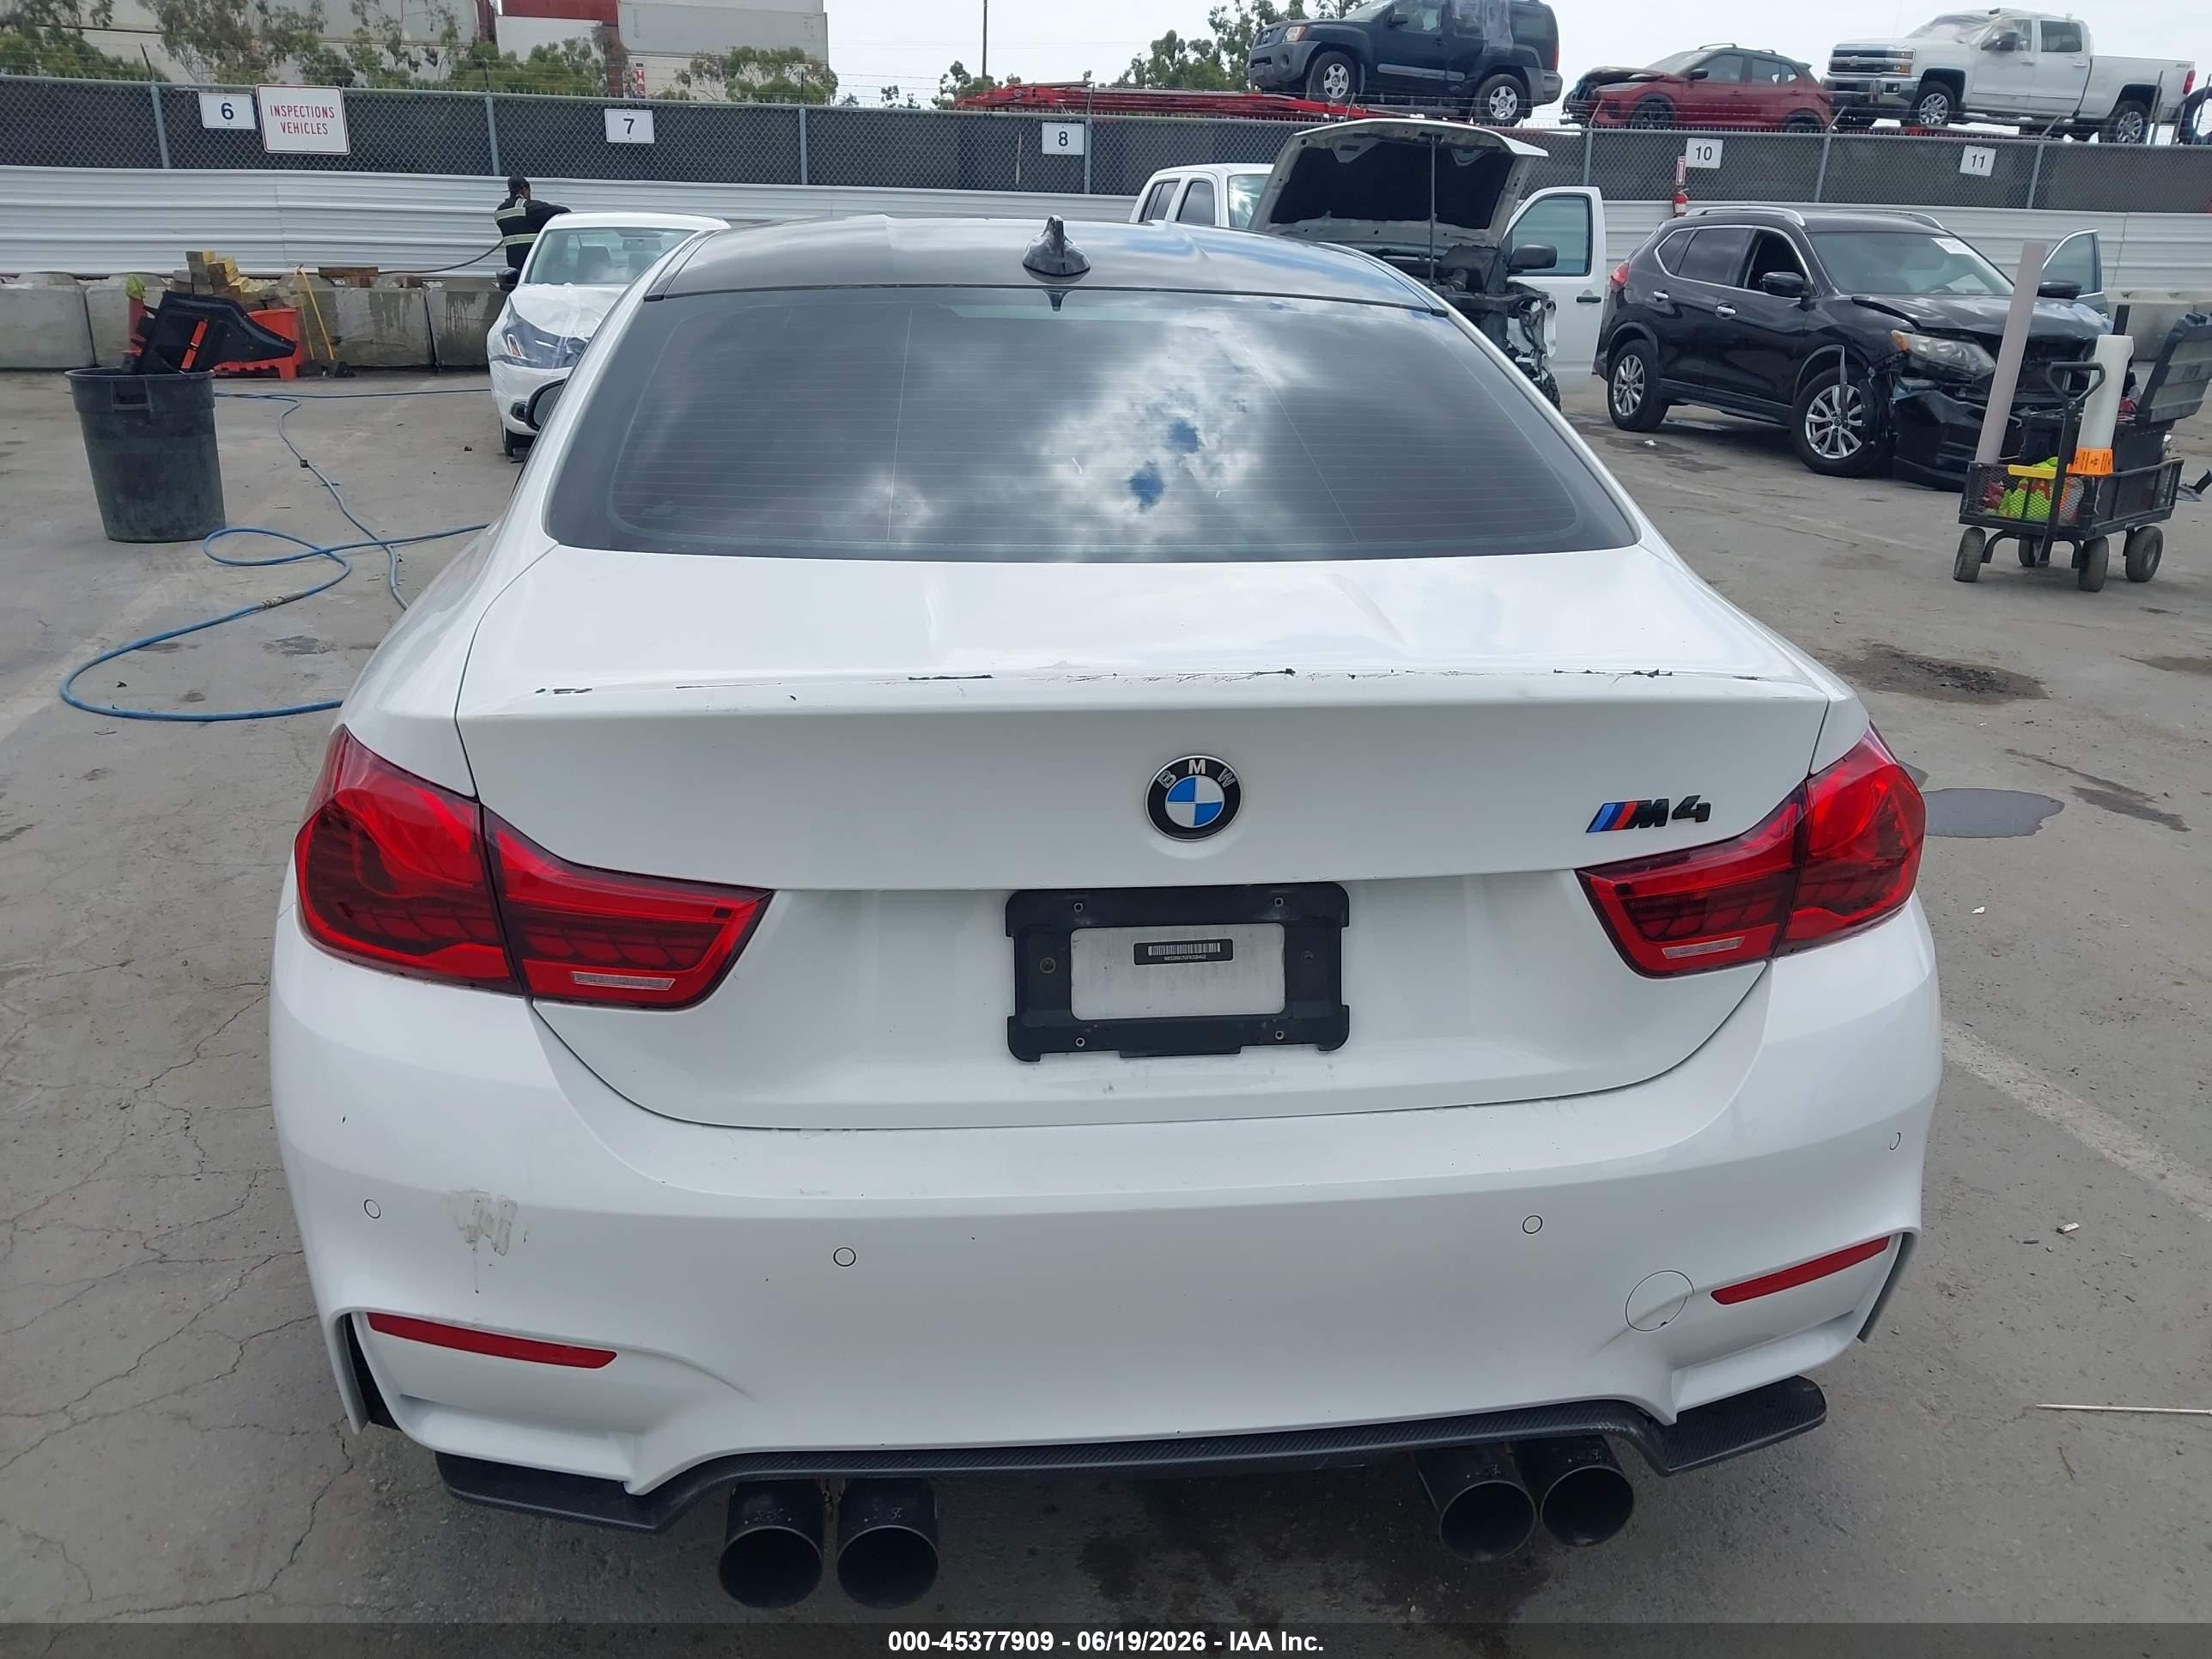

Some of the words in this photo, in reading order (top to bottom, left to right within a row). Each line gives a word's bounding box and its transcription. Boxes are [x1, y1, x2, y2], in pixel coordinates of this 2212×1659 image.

[221, 102, 234, 119] 6
[270, 104, 335, 118] INSPECTIONS
[280, 122, 328, 135] VEHICLES
[623, 118, 635, 134] 7
[1058, 131, 1068, 147] 8
[1695, 145, 1712, 161] 10
[1972, 154, 1985, 168] 11
[1157, 759, 1237, 789] BMW
[1616, 794, 1711, 831] M4
